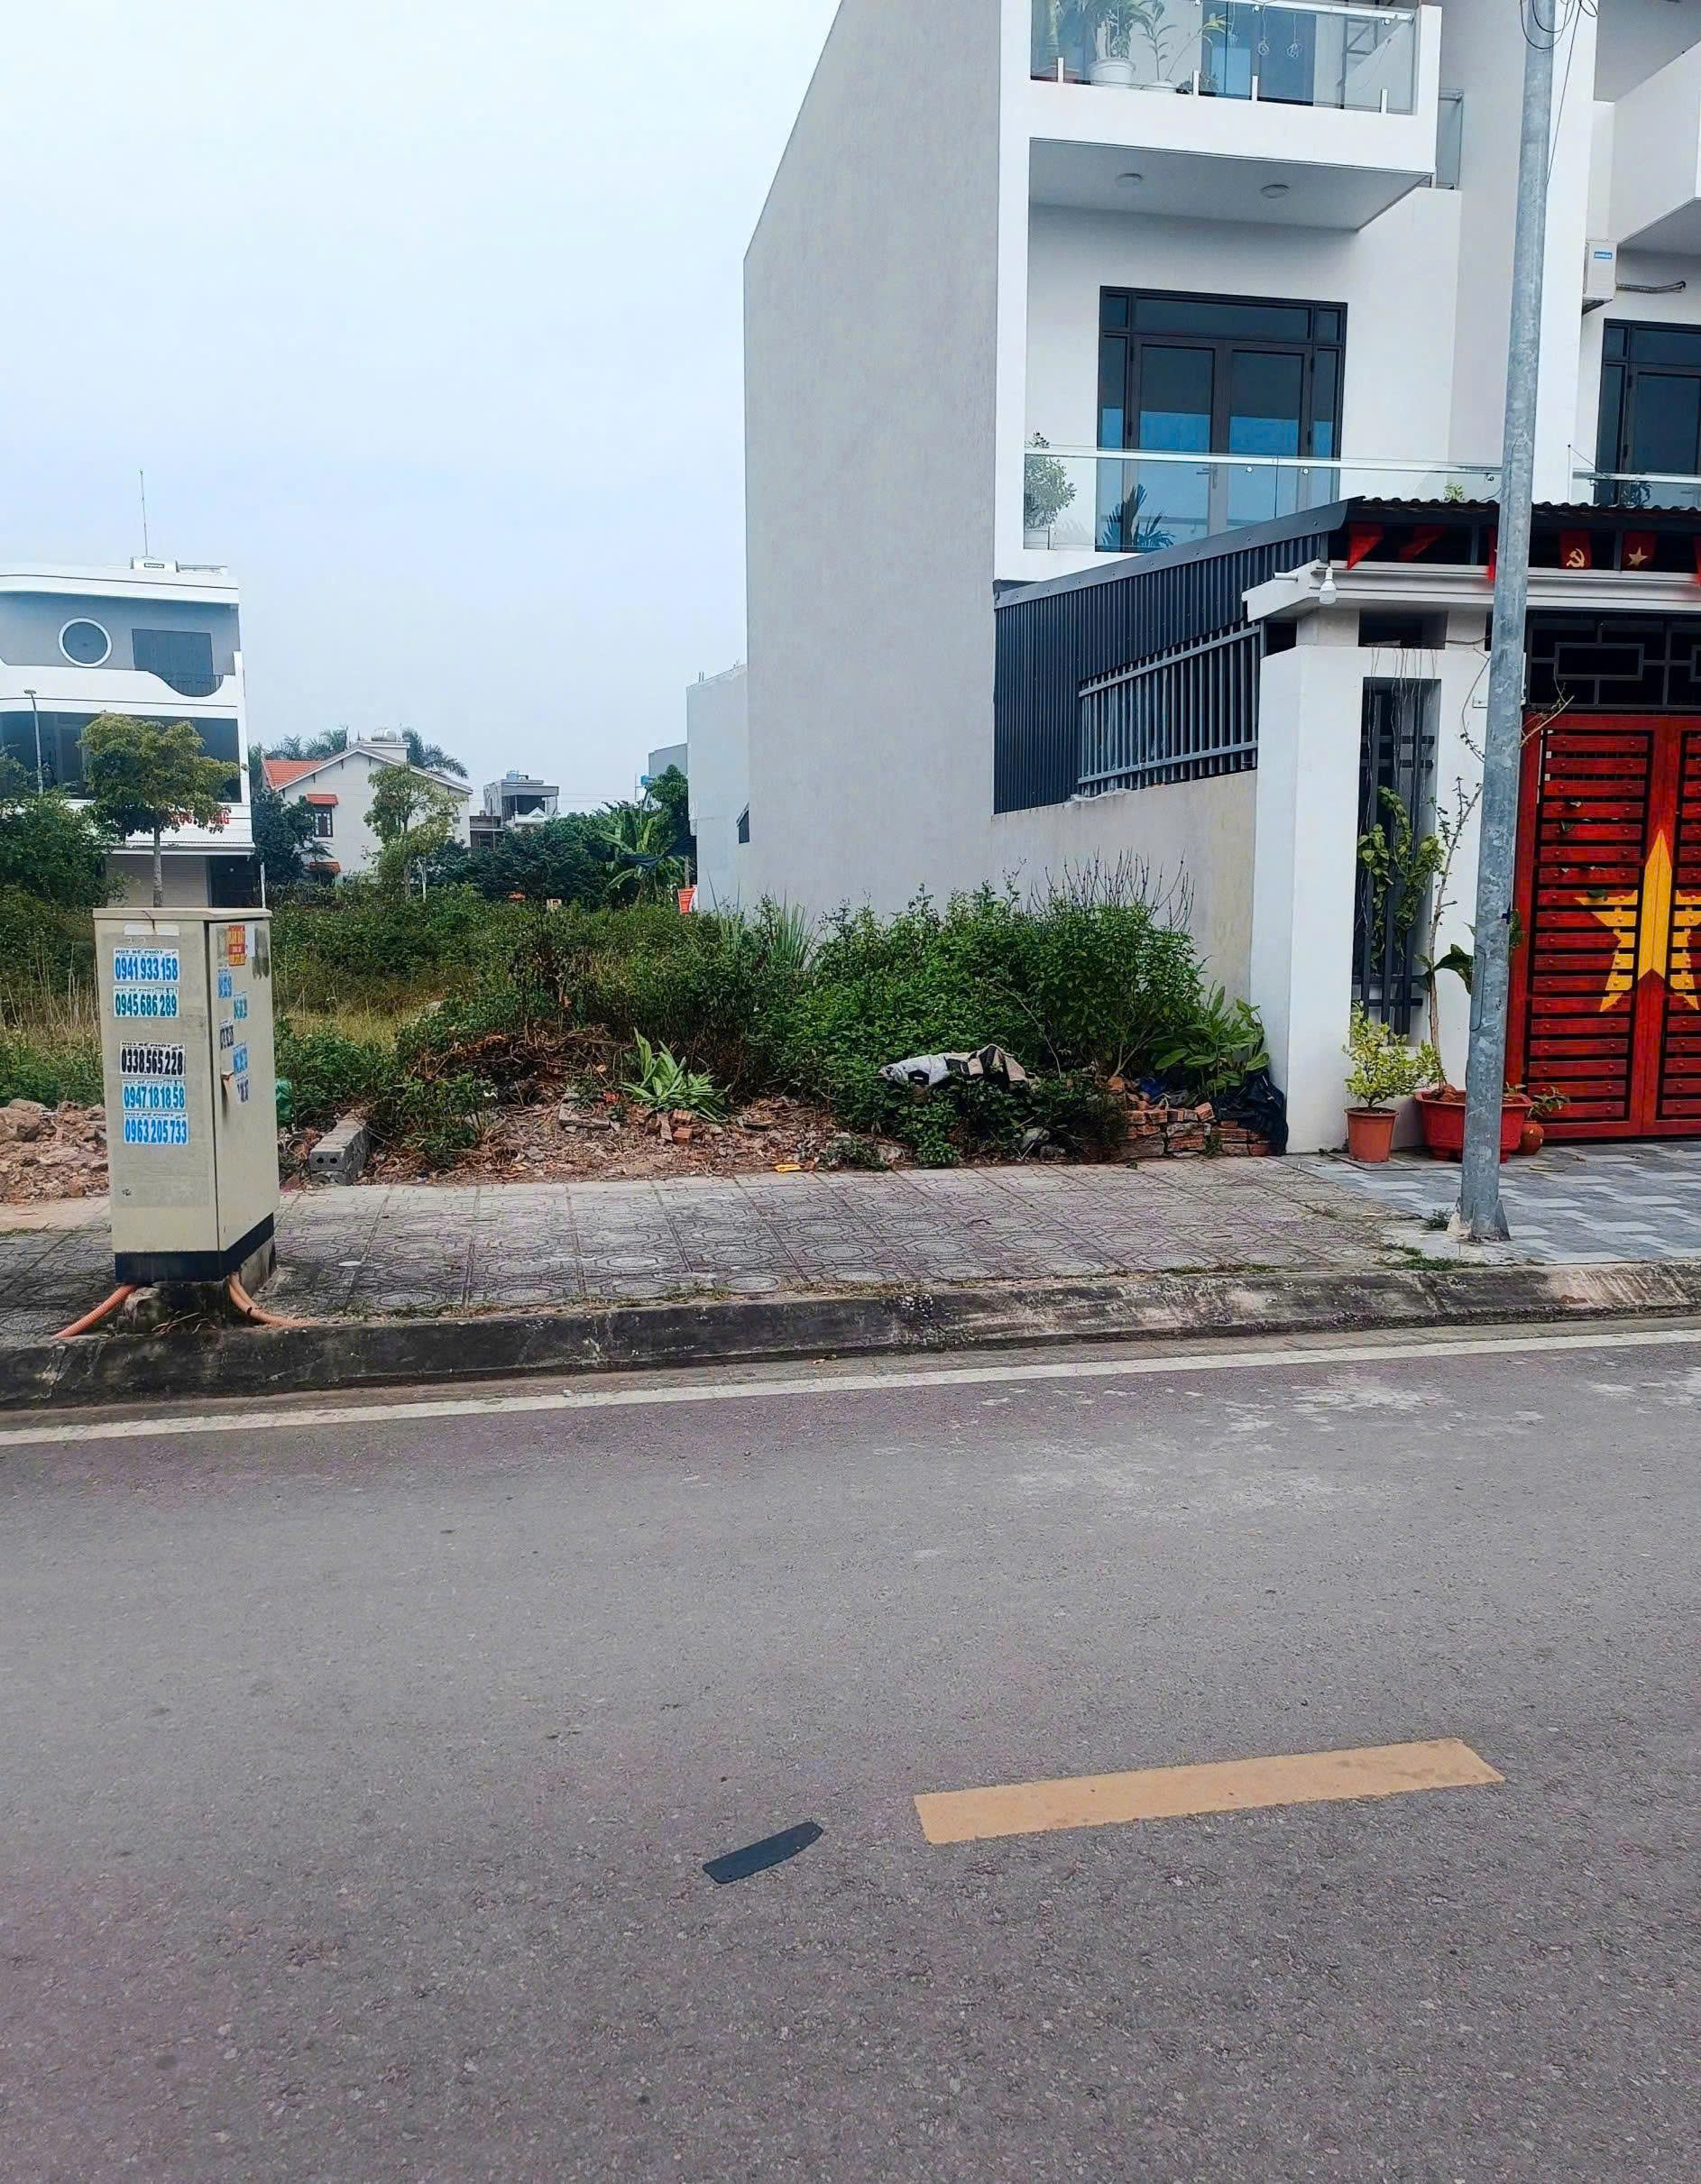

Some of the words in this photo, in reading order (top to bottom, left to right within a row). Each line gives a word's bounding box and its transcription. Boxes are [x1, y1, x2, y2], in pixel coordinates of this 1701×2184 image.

[115, 957, 178, 981] 0941.933.158
[115, 993, 177, 1017] 0945.686.289
[124, 1086, 185, 1108] 0947.18.18.58
[125, 1118, 188, 1144] 0963.205.733
